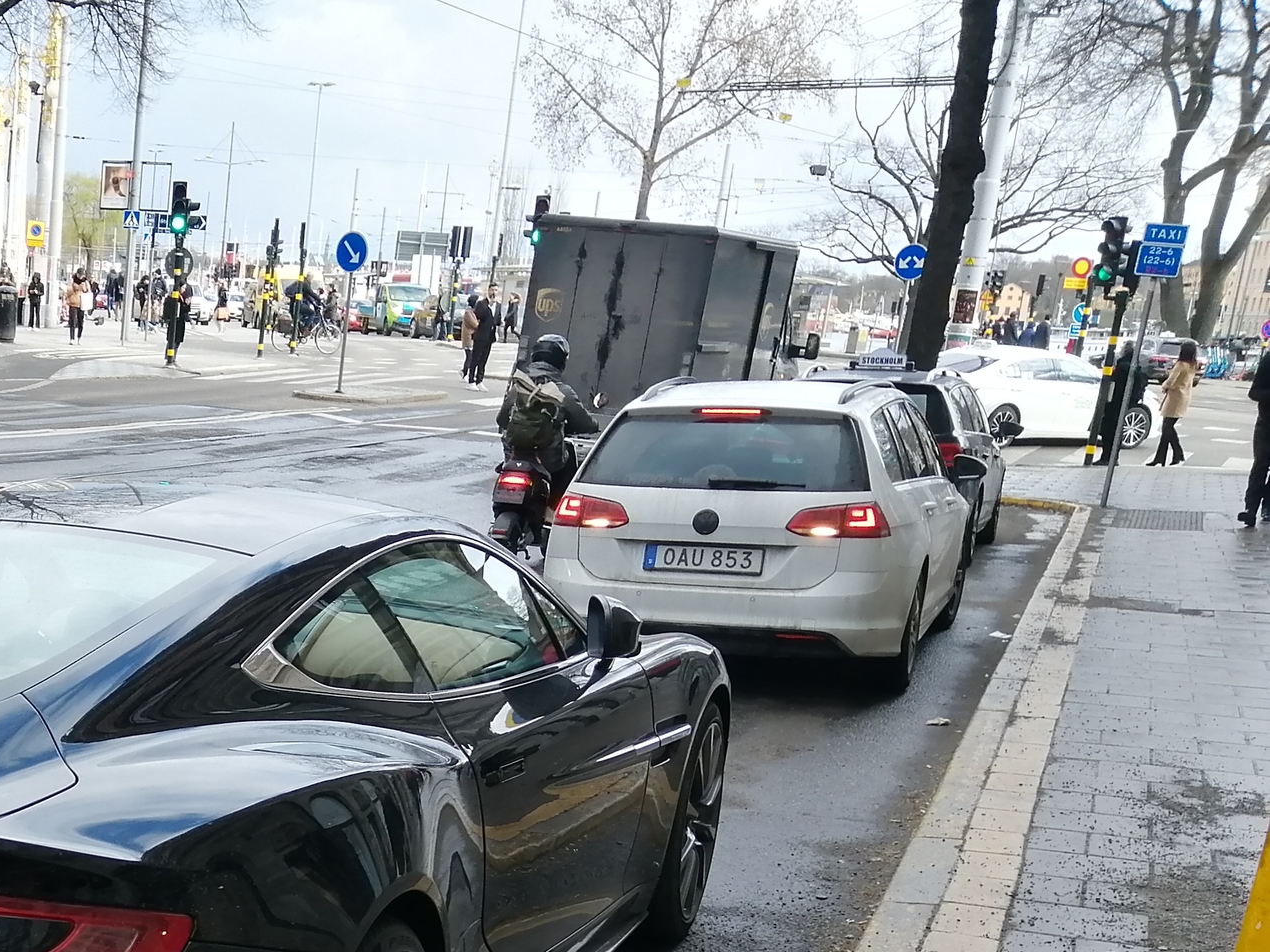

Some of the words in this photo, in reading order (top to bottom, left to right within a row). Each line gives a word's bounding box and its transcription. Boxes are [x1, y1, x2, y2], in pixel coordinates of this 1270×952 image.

[1150, 228, 1182, 240] TAXI
[1149, 246, 1174, 256] 22-6
[1143, 255, 1175, 267] (22-6)
[862, 356, 903, 365] STOCKHOLM
[663, 548, 705, 566] OAU
[711, 550, 753, 569] 853
